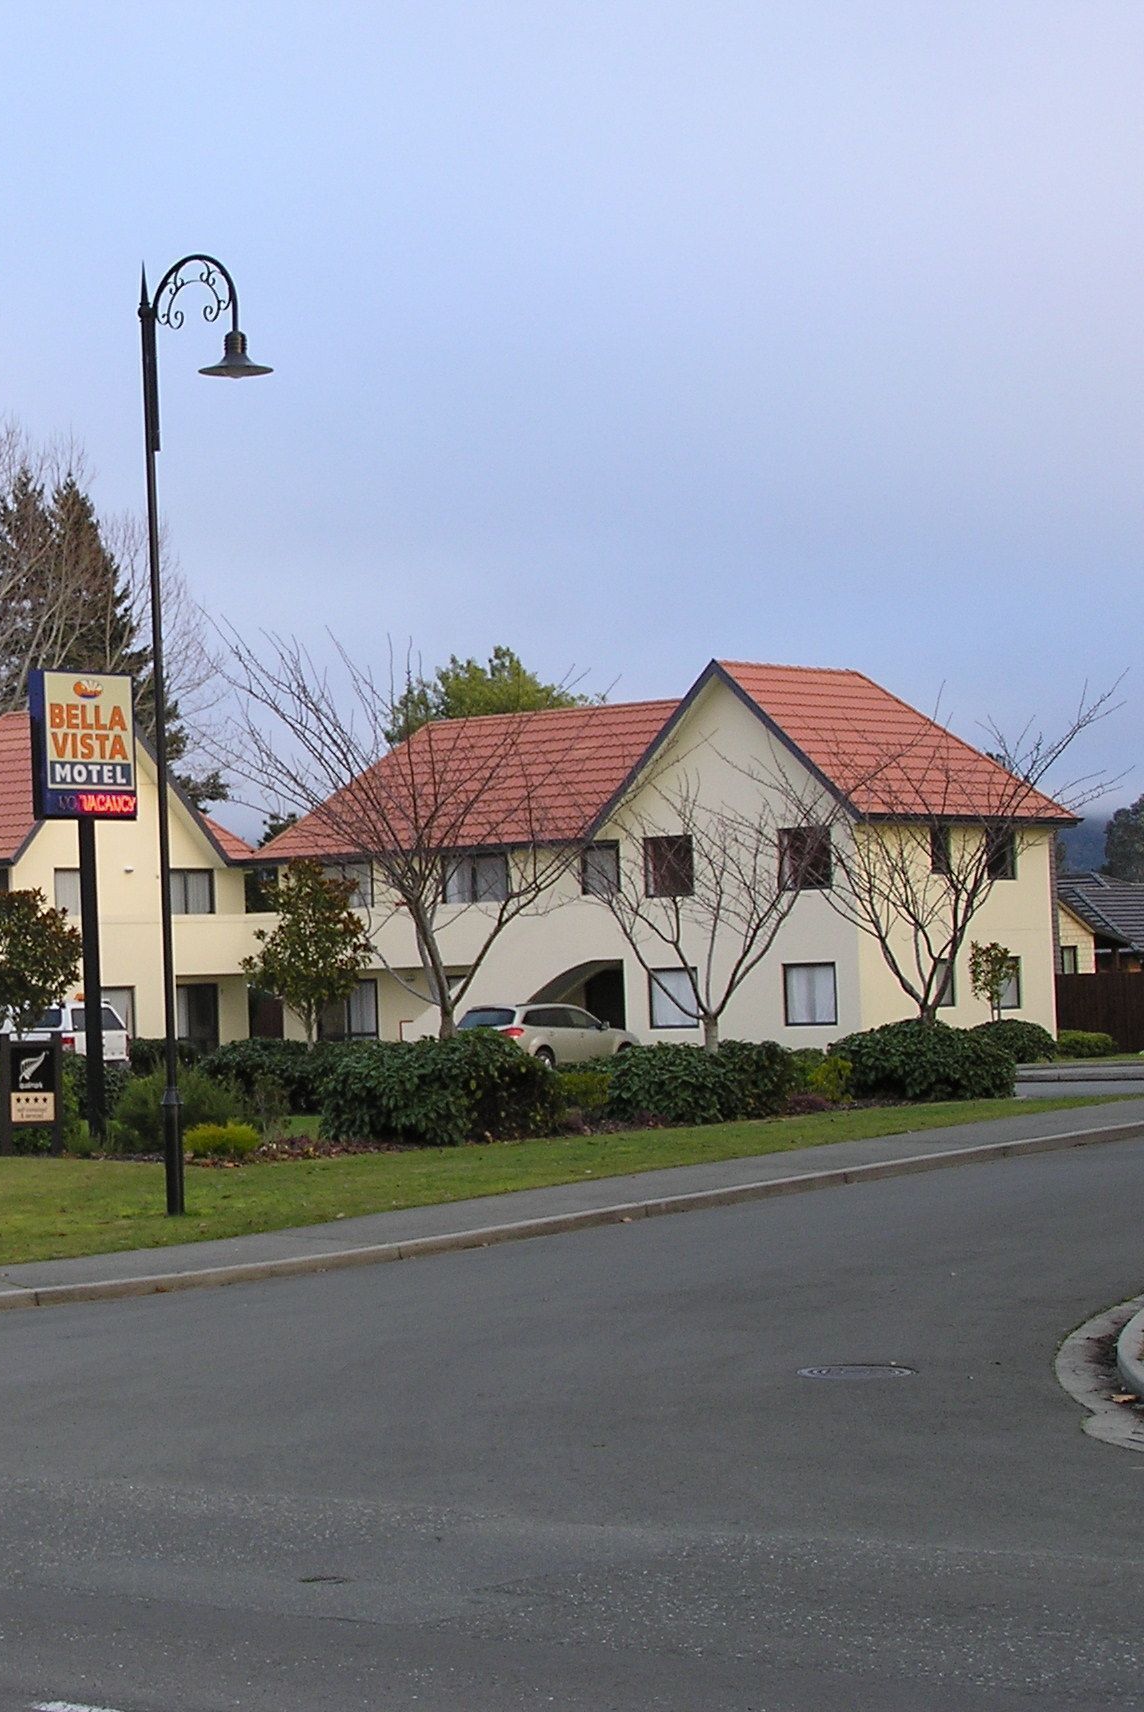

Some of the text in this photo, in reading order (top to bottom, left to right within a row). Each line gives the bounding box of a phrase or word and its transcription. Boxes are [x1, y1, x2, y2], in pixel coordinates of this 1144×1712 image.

[50, 704, 127, 731] BELLA
[51, 732, 128, 760] VISTA
[55, 764, 126, 784] MOTEL
[78, 795, 136, 812] VACANCY
